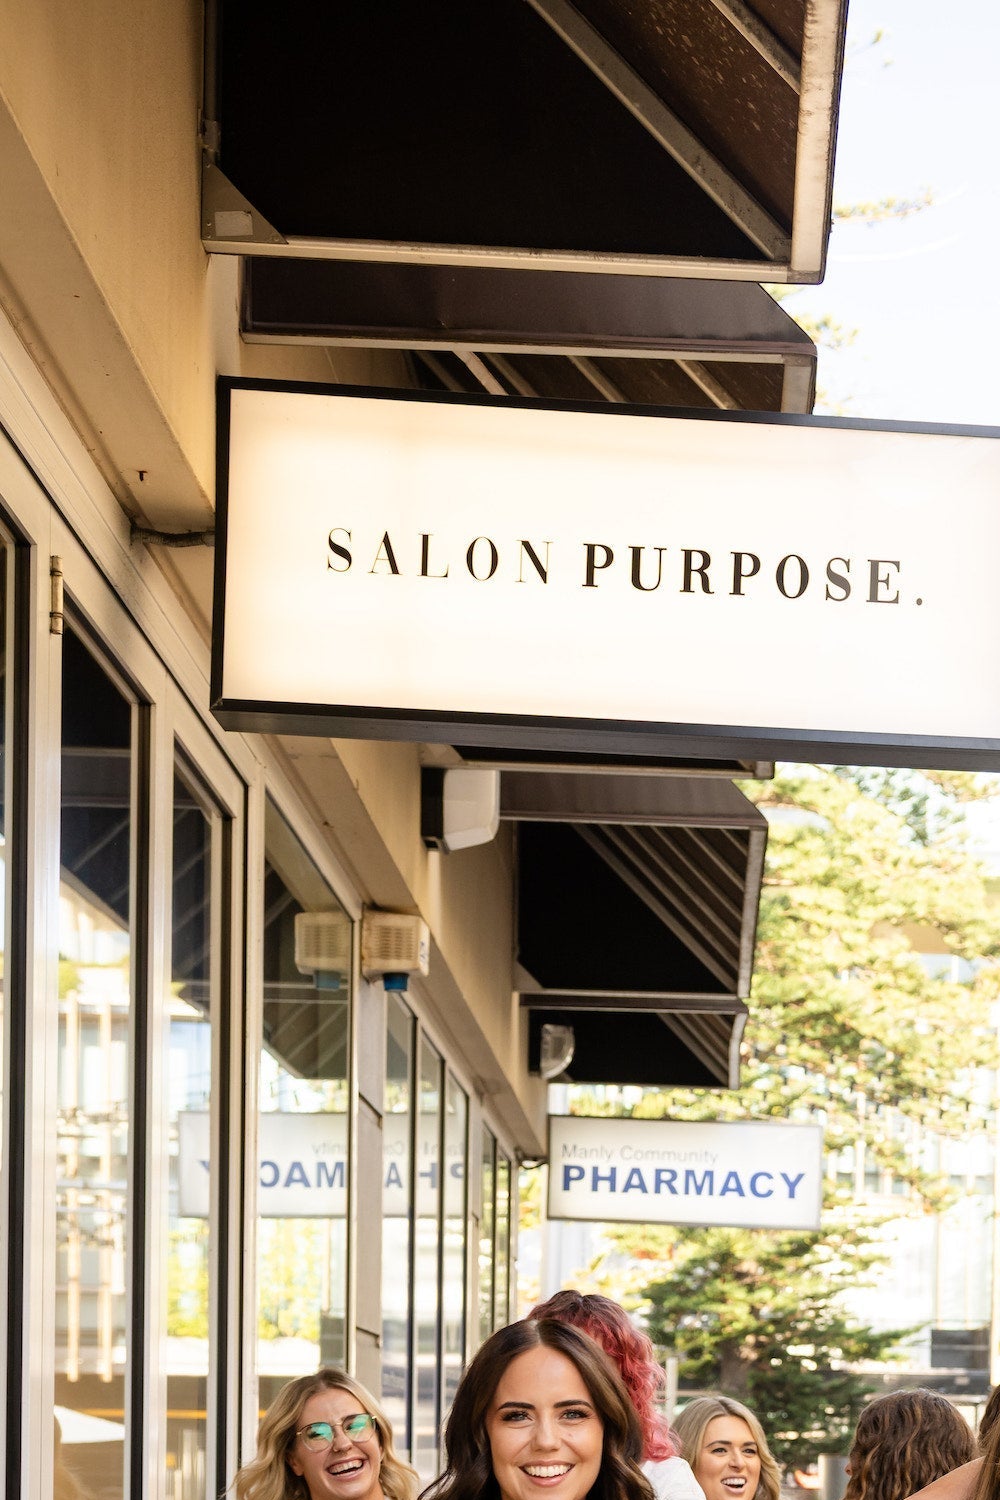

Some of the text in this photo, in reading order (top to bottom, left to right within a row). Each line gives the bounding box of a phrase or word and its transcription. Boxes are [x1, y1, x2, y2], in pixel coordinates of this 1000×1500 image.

[327, 527, 924, 607] SALON PURPOSE.
[561, 1143, 719, 1164] Manly Community
[561, 1164, 806, 1199] PHARMACY
